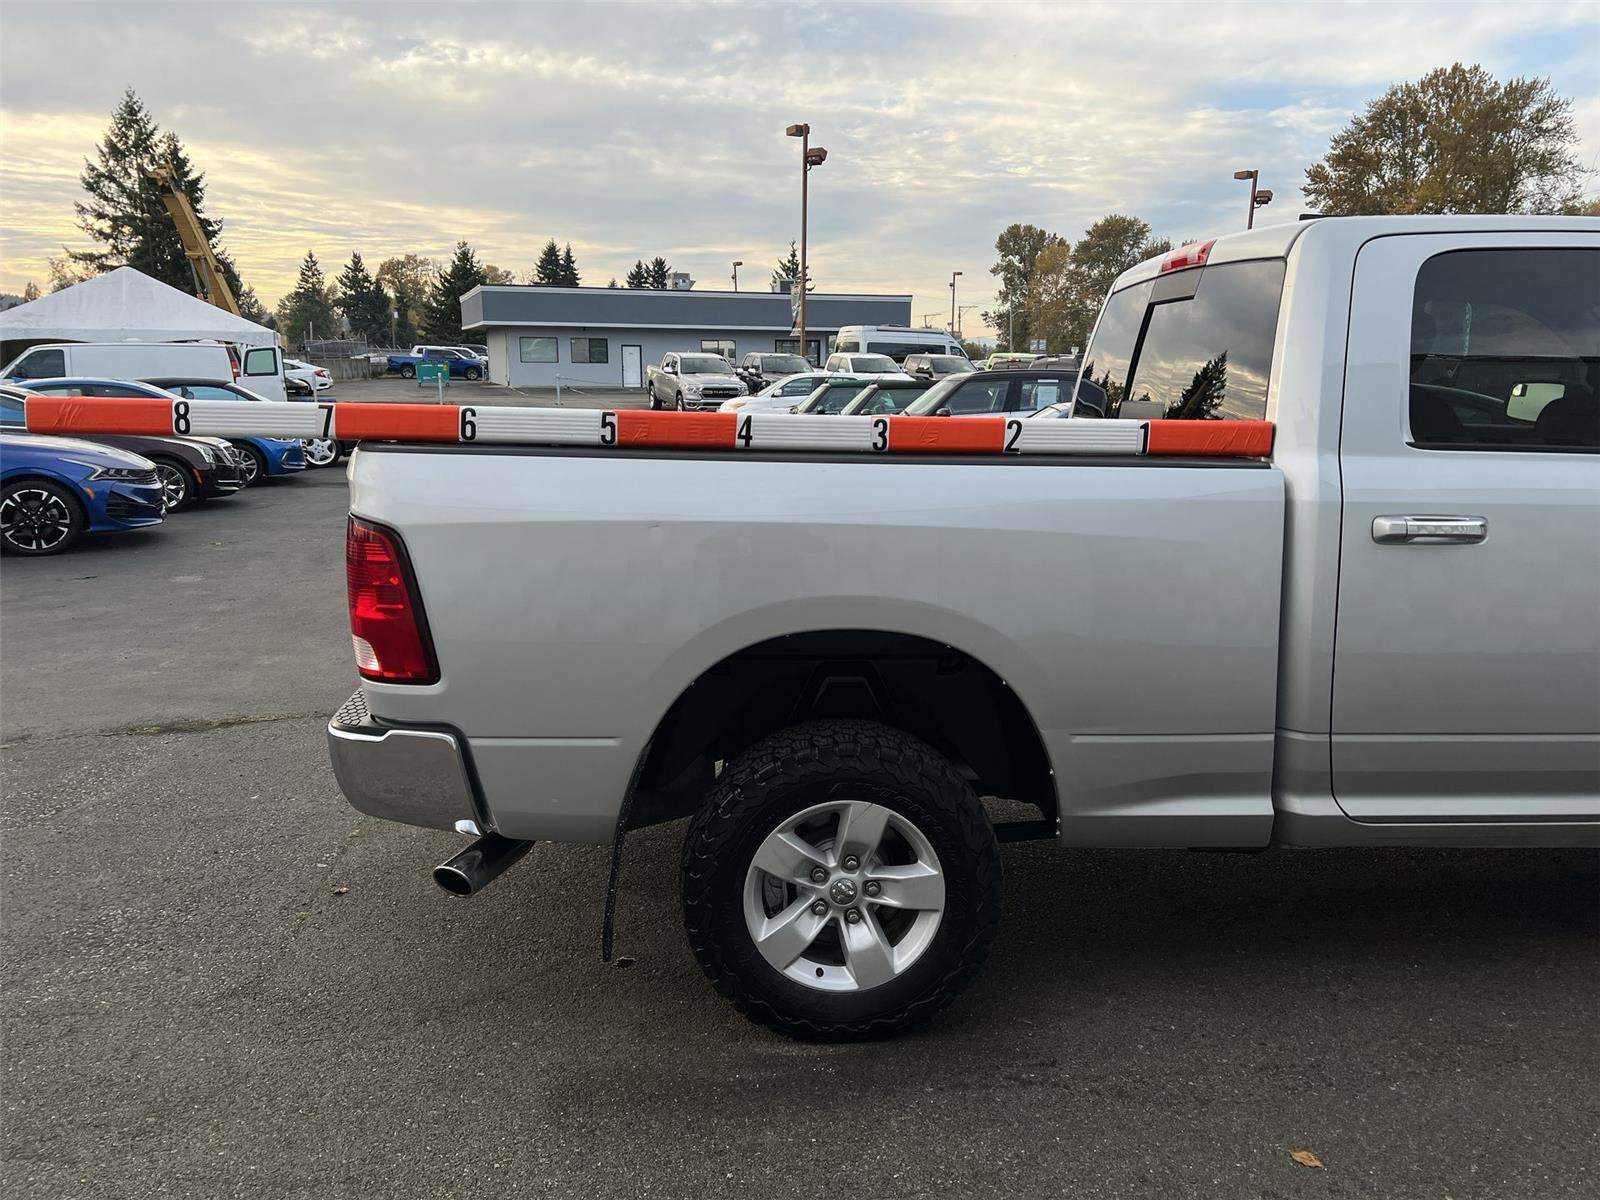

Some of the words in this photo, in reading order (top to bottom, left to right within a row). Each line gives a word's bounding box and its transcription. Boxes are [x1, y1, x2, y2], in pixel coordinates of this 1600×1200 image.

[174, 401, 191, 434] 8
[318, 404, 333, 438] 7
[460, 408, 477, 441] 6
[600, 411, 616, 444] 5
[737, 415, 753, 448] 4
[872, 418, 888, 451] 3
[1005, 419, 1023, 453] 2
[1139, 421, 1150, 454] 1
